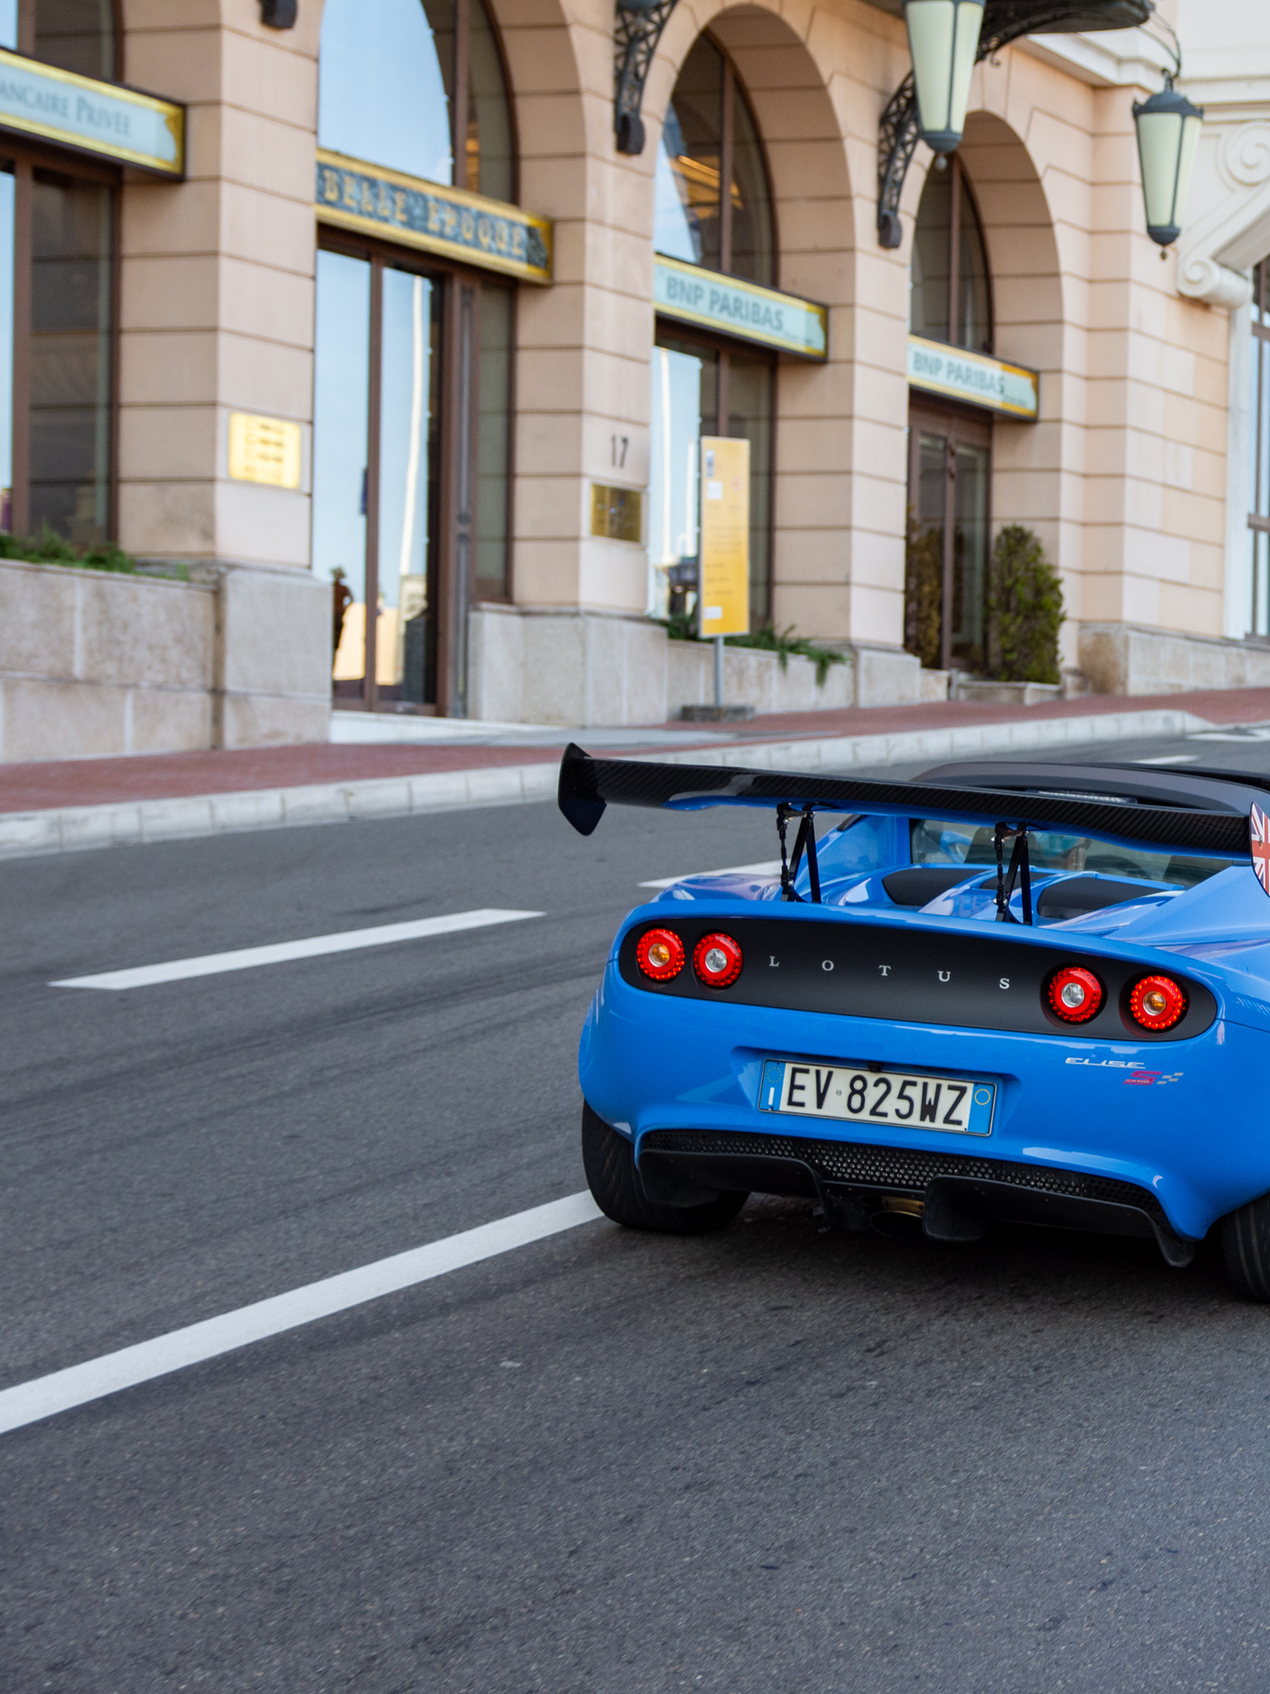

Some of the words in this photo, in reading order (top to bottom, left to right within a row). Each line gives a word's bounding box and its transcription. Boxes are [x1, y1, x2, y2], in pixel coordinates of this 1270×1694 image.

[323, 169, 407, 222] BELLE
[427, 200, 524, 255] EPOQUE
[666, 276, 704, 306] BNP
[709, 288, 784, 331] PARIBAS
[913, 351, 943, 376] BNP
[946, 361, 1005, 394] PARIBAS
[611, 434, 629, 467] 17
[768, 955, 1010, 990] LOTUS
[1065, 1057, 1146, 1069] ELISE
[787, 1067, 834, 1109] EV
[846, 1073, 968, 1126] 825WZ
